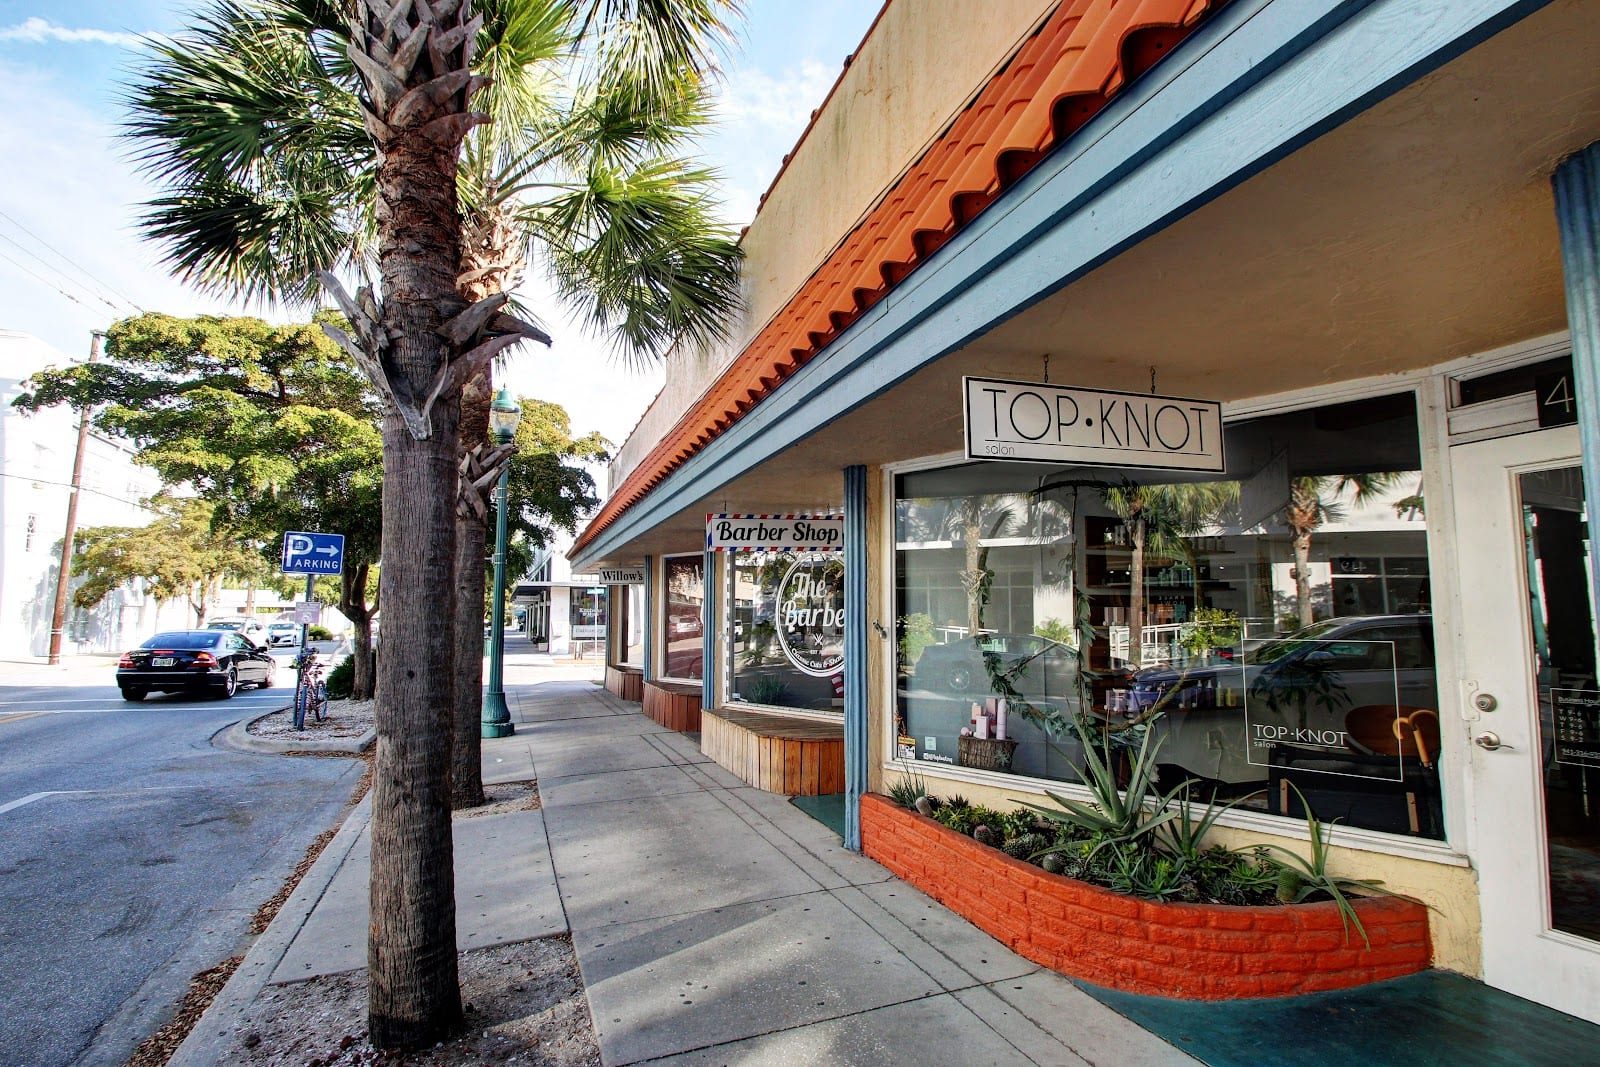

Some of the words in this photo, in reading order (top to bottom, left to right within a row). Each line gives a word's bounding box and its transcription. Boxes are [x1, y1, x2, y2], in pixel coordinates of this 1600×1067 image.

[1543, 375, 1575, 413] 4
[985, 444, 1015, 455] salon
[716, 521, 788, 541] Barber
[792, 521, 839, 545] Shop
[602, 570, 643, 581] Willow's
[792, 572, 827, 599] The
[782, 600, 845, 628] Barbe
[1253, 741, 1277, 749] salon
